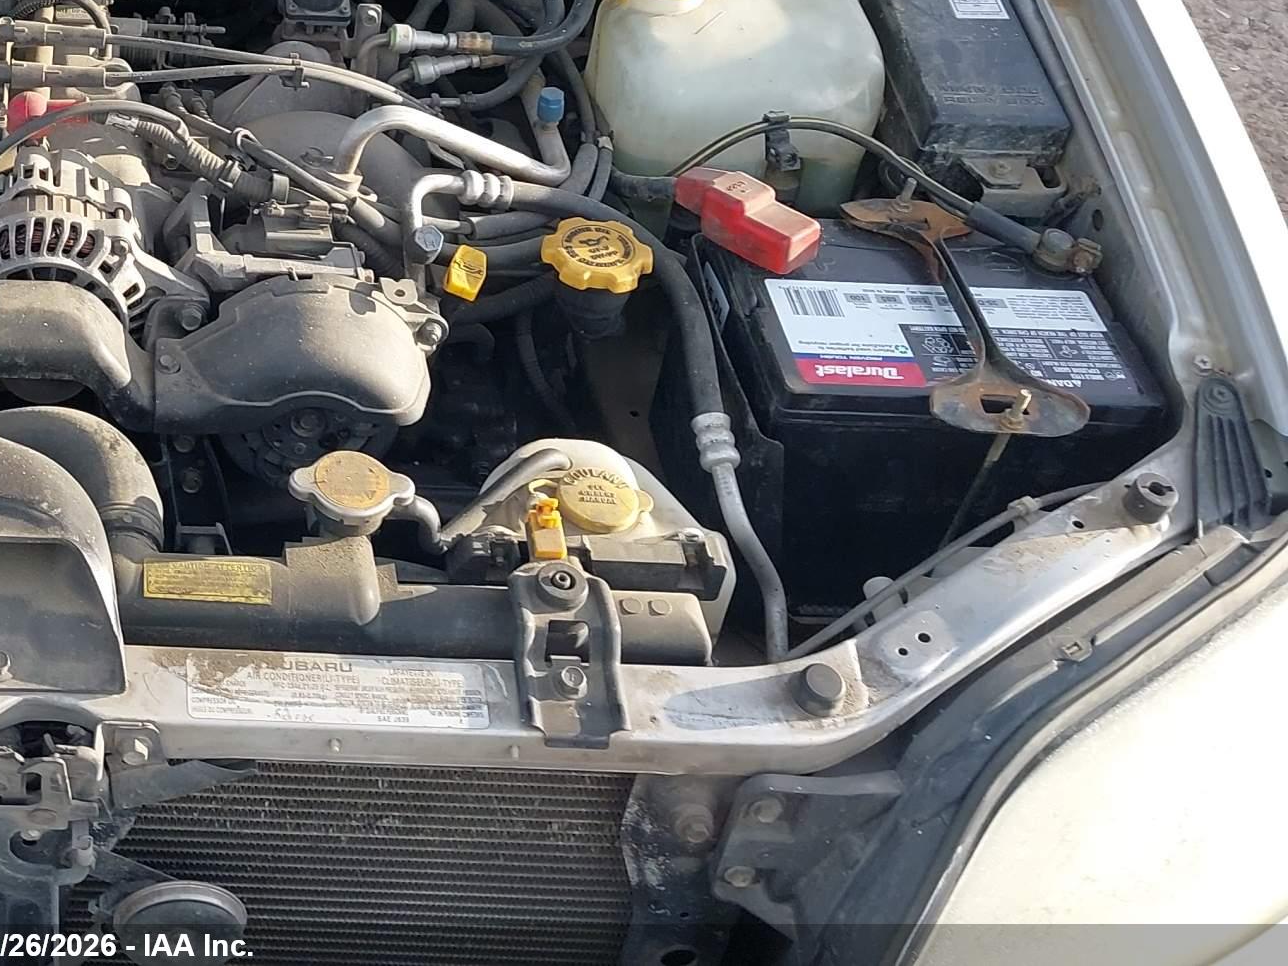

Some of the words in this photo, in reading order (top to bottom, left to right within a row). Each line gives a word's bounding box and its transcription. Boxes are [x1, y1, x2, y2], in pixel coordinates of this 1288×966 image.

[814, 364, 905, 380] Duralast
[563, 468, 629, 489] COOLANT
[267, 660, 353, 673] UBARU
